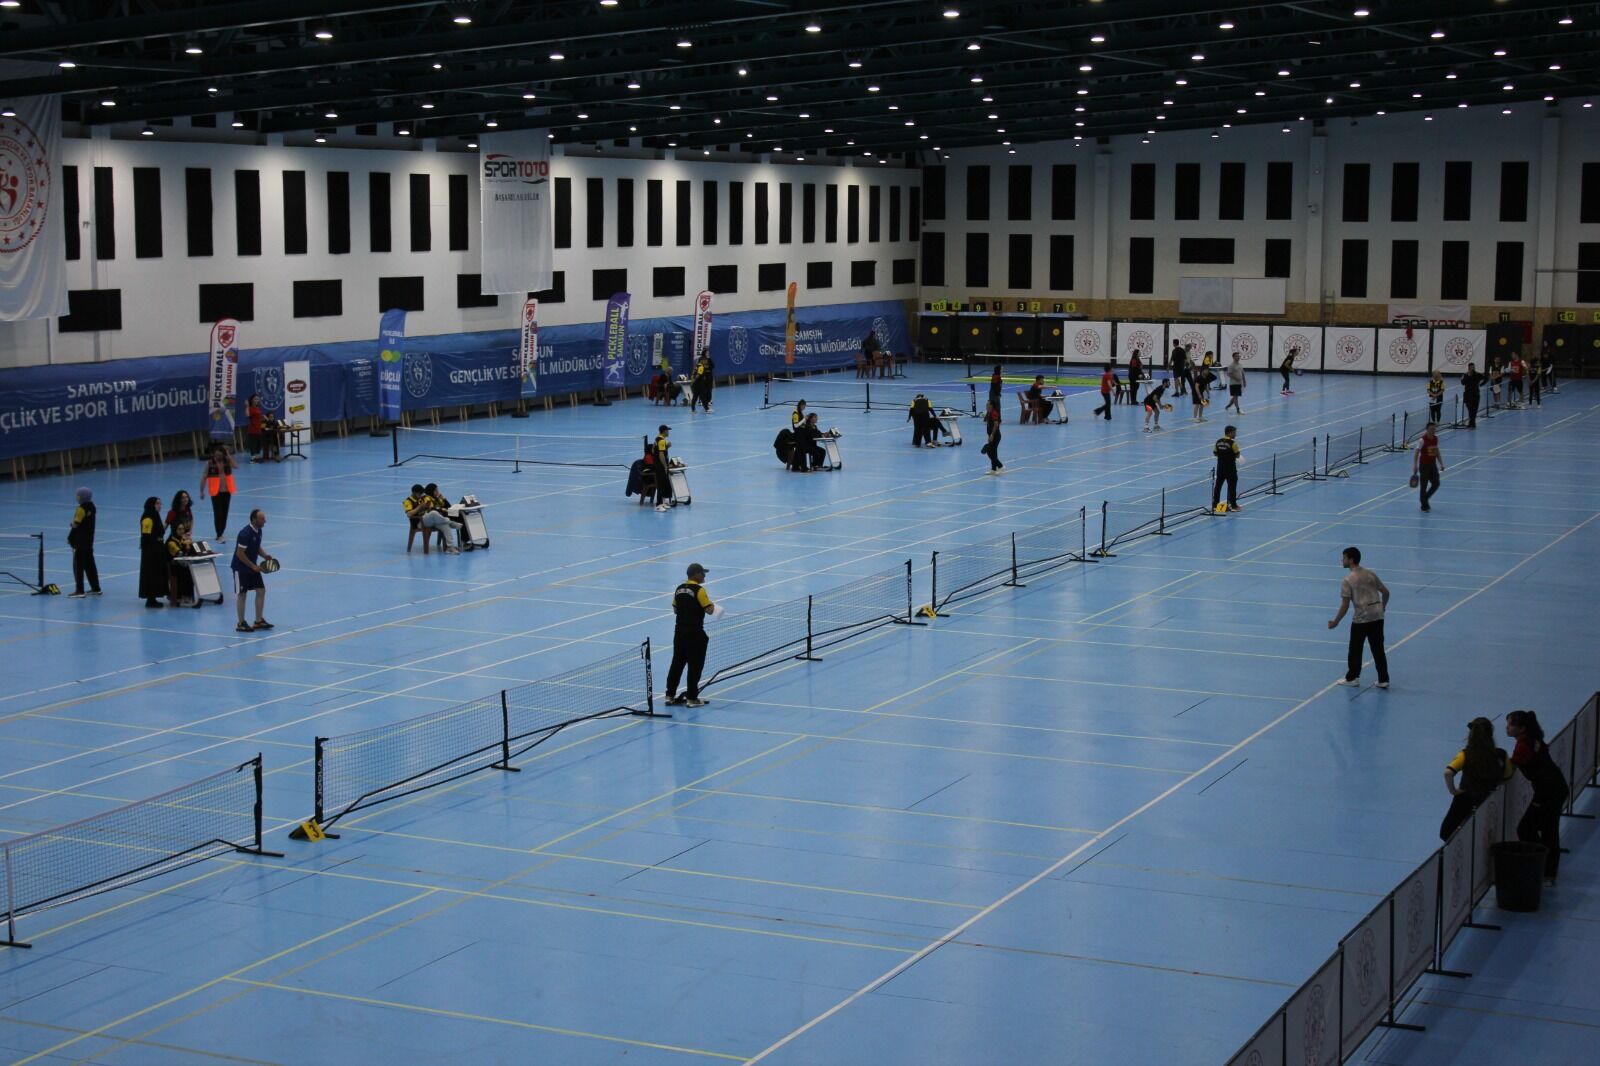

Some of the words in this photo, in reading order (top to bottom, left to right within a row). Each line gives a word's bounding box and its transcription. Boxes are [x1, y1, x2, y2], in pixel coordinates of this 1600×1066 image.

[1055, 304, 1061, 313] 7
[607, 307, 620, 360] PICKLEBALL
[511, 345, 554, 361] SUN
[450, 366, 494, 387] GENÇLİK
[495, 366, 509, 380] VE
[539, 360, 548, 376] İL
[549, 353, 605, 375] MÜDÜRLÜĞ
[66, 379, 138, 399] SAMSUN
[0, 408, 38, 434] ÇLİK
[40, 406, 62, 425] VE
[64, 399, 109, 421] SPOR
[114, 394, 129, 415] İL
[131, 384, 209, 413] MÜDÜRLÜ
